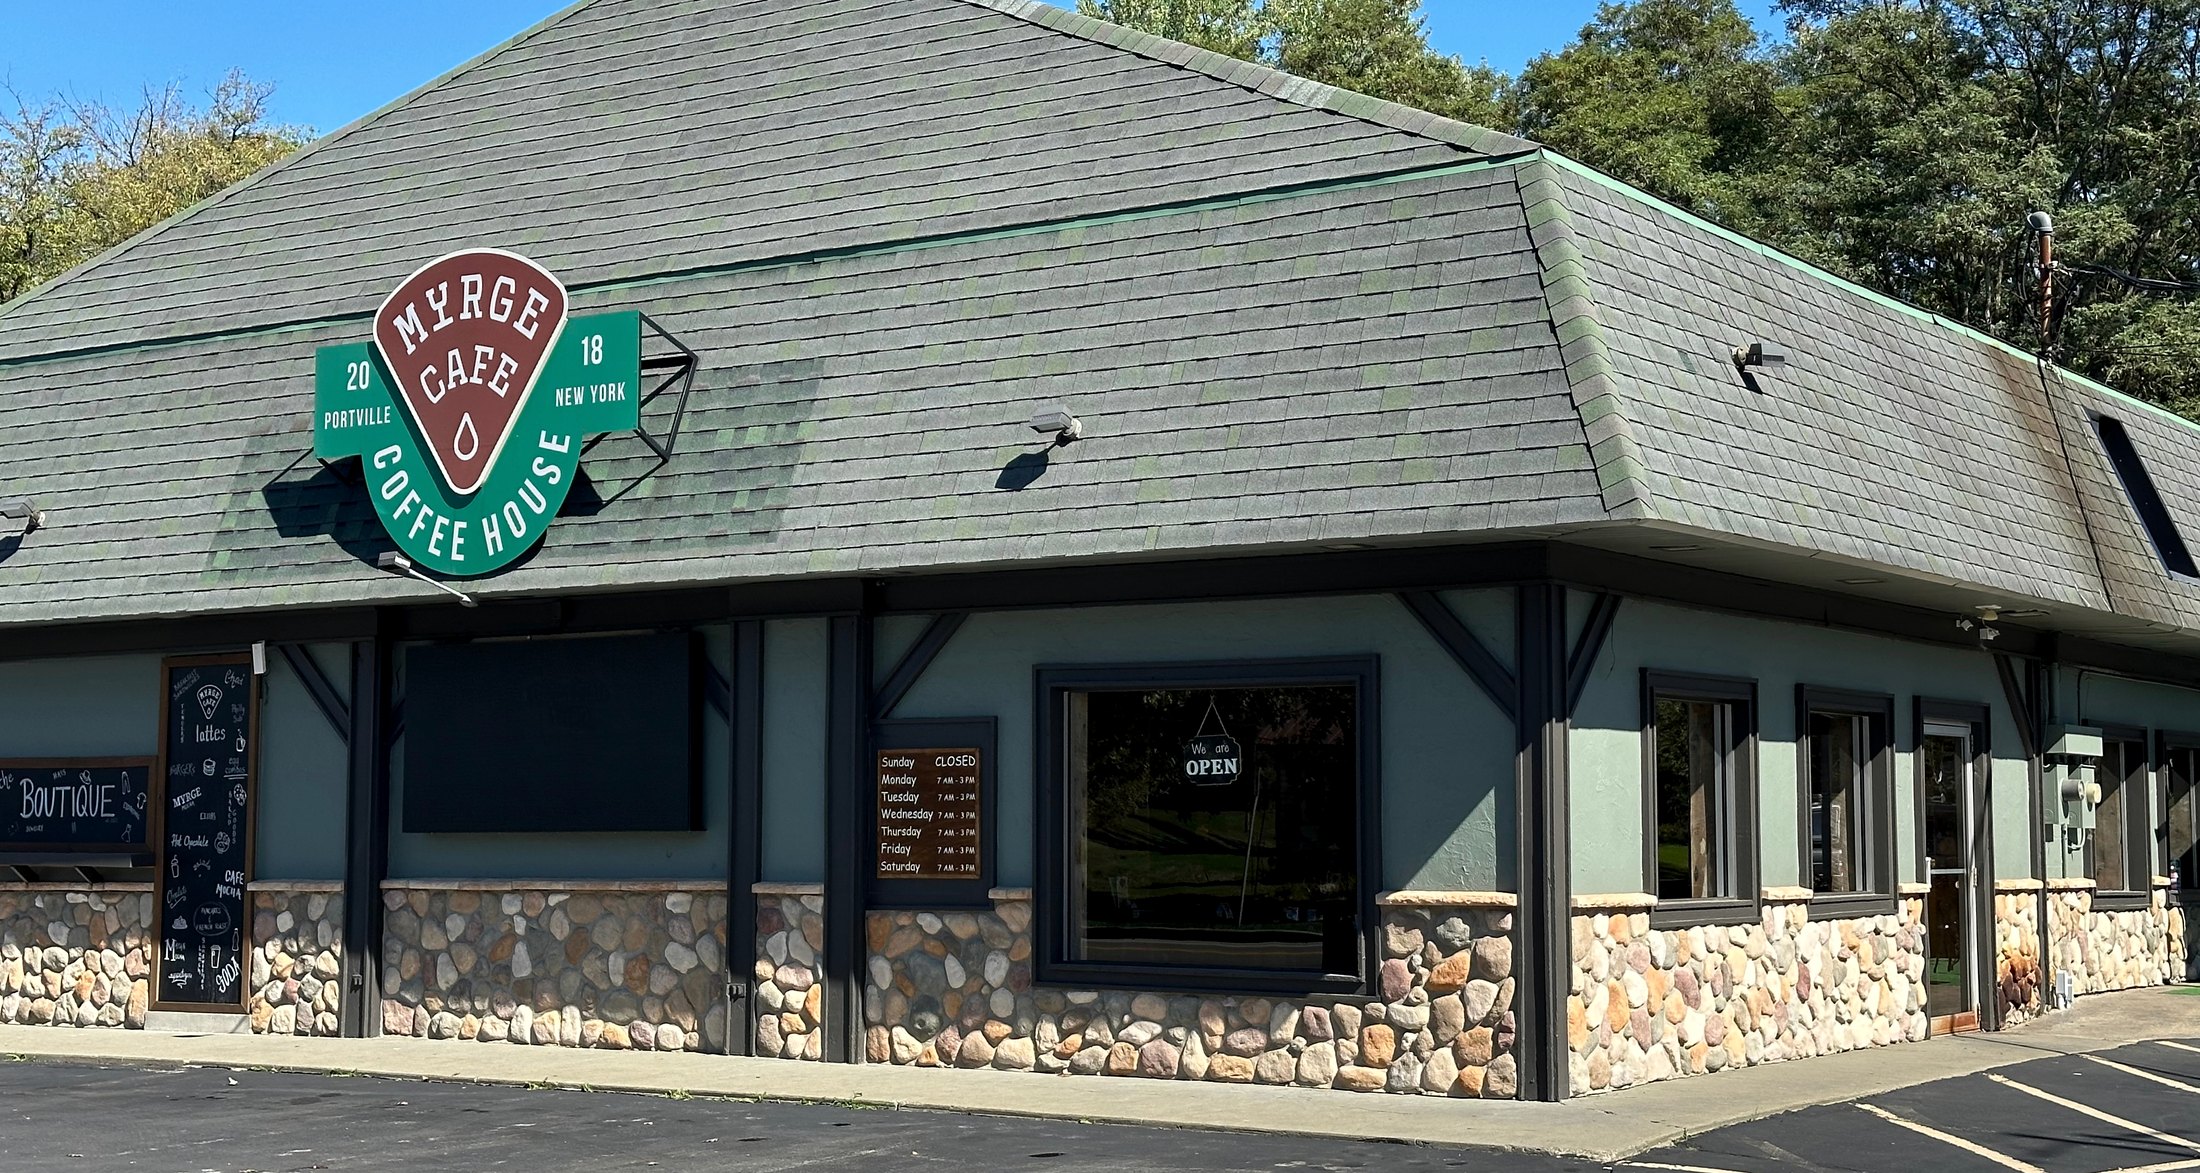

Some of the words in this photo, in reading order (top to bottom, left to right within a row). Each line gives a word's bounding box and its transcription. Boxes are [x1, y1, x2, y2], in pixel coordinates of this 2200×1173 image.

[393, 274, 550, 355] MYRGE
[581, 334, 603, 367] 18
[347, 360, 370, 391] 20
[420, 345, 519, 404] CAFE
[555, 386, 585, 407] NEW
[590, 382, 626, 404] YORK
[324, 405, 391, 429] PORTVILLE
[373, 444, 468, 561] COFFEE
[481, 430, 571, 556] HOUSE
[195, 724, 226, 743] lattes
[1191, 742, 1207, 755] We
[1215, 744, 1230, 753] are
[881, 757, 915, 769] Sunday
[935, 755, 976, 767] CLOSED
[1186, 758, 1238, 776] OPEN
[881, 774, 917, 787] Monday
[960, 776, 964, 784] 3
[966, 776, 975, 784] PM
[20, 778, 115, 818] BOUTIQUE
[172, 786, 202, 808] MYRGE
[881, 791, 919, 804] Tuesday
[881, 808, 934, 822] Wednesday
[881, 826, 922, 839] Thursday
[881, 843, 911, 856] Friday
[880, 861, 920, 874] Saturday
[937, 864, 942, 872] 7
[943, 864, 954, 872] AM
[960, 864, 964, 872] 3
[966, 864, 976, 872] PM
[225, 869, 245, 885] CAFE
[215, 883, 242, 901] MOCHA
[215, 955, 242, 993] SODA
